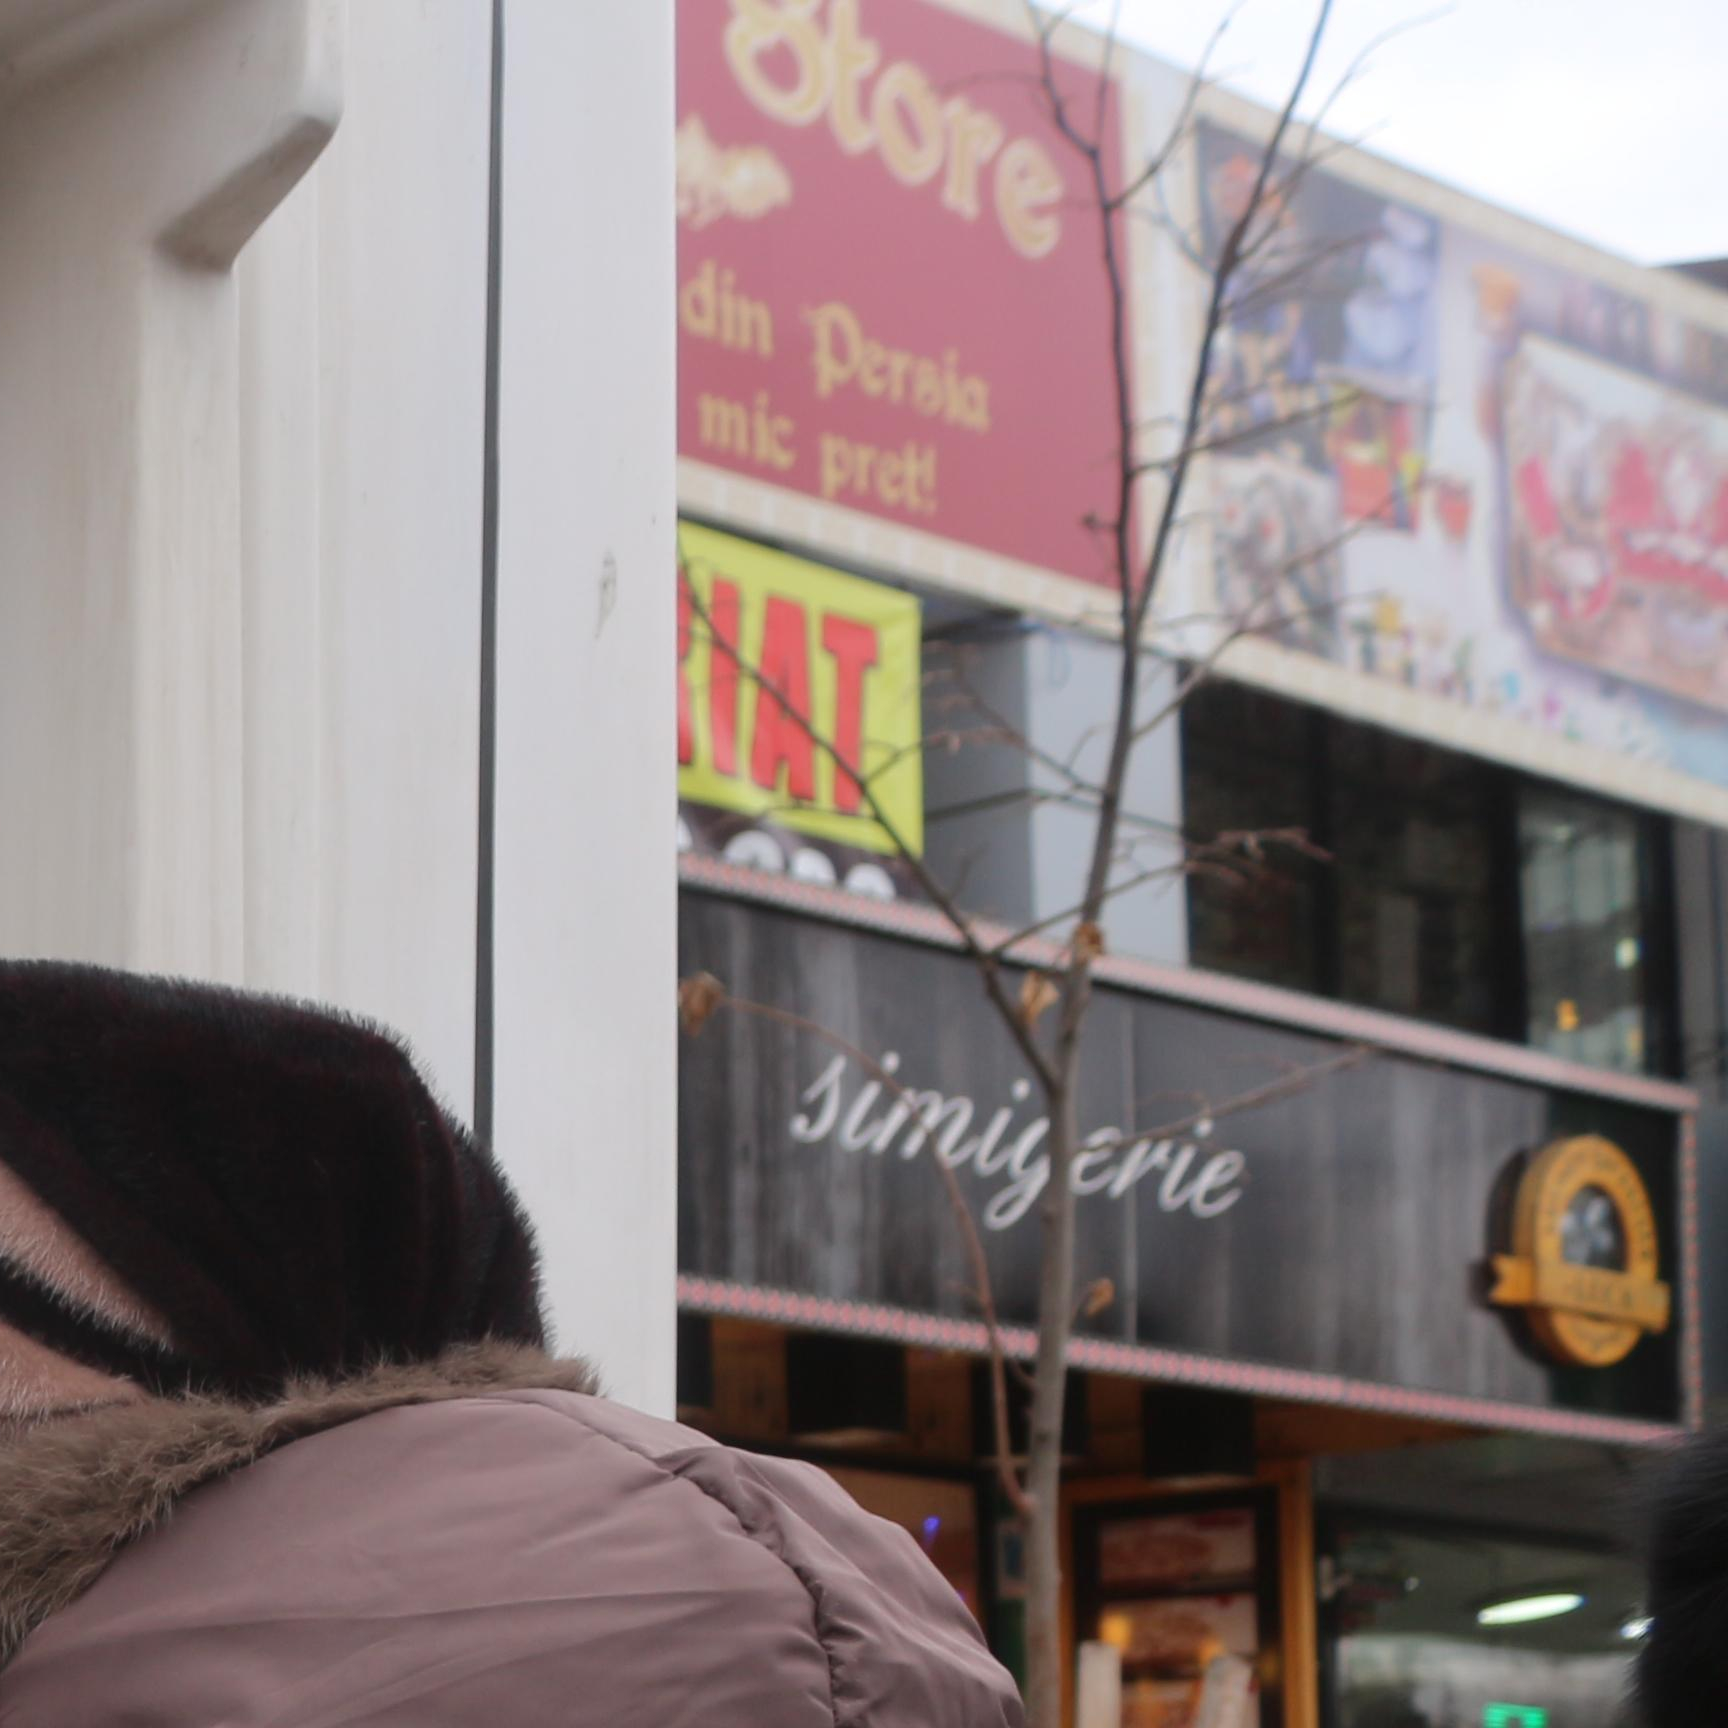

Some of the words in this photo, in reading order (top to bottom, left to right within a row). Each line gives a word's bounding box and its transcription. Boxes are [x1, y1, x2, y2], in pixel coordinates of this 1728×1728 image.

[722, 0, 1068, 262] Store
[679, 260, 775, 360] din
[804, 303, 994, 434] Persia
[697, 393, 799, 472] mic
[818, 427, 939, 516] pret!
[788, 1052, 1249, 1231] simigerie
